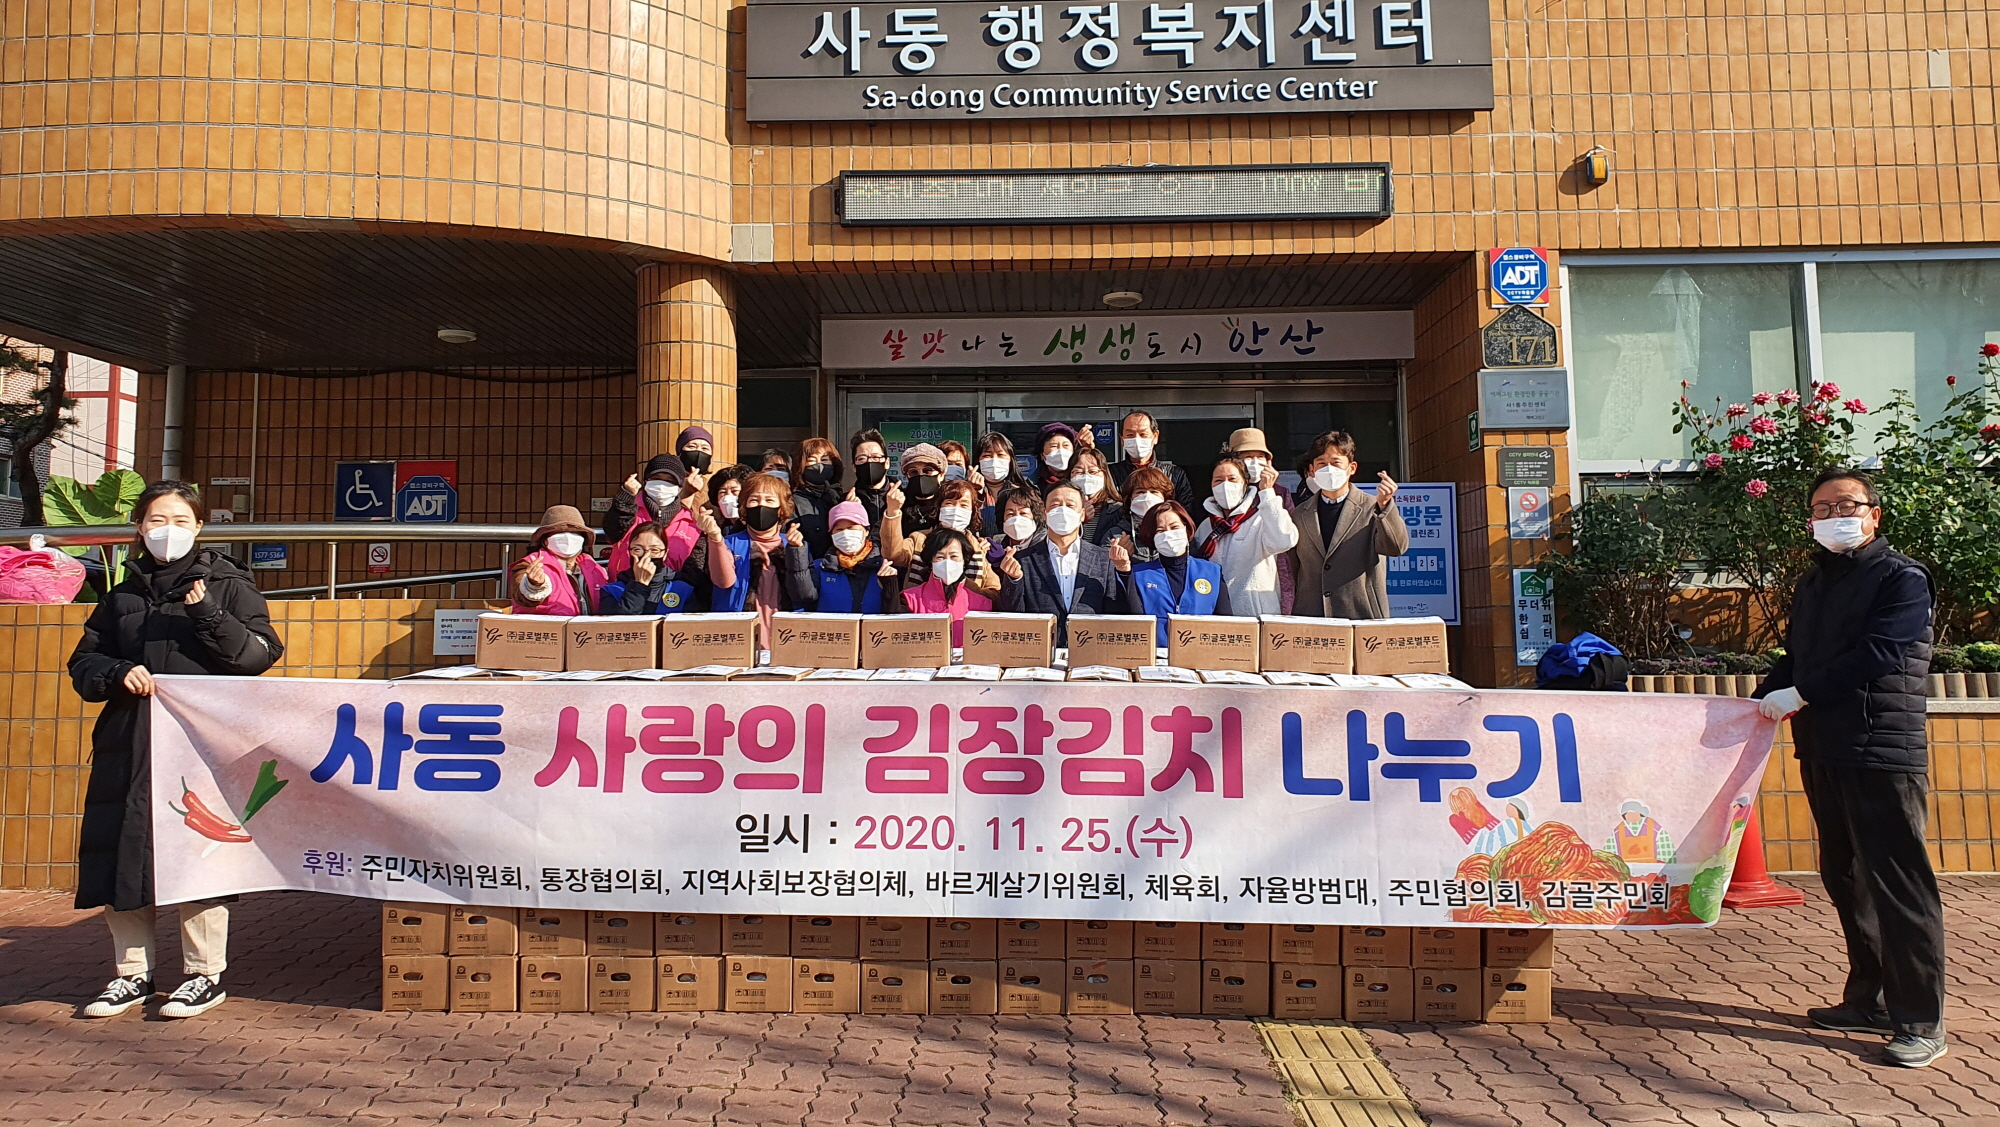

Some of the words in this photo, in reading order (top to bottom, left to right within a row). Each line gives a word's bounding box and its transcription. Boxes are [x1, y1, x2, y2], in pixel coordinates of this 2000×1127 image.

[807, 7, 949, 72] 사동
[987, 0, 1434, 69] 행정복지센터
[866, 84, 985, 112] Sa-dong
[993, 80, 1161, 109] Community
[1169, 78, 1272, 102] Service
[1280, 77, 1379, 100] Center
[1501, 265, 1540, 286] ADT
[1226, 318, 1325, 356] 안산
[1507, 336, 1554, 363] 171
[1097, 428, 1112, 437] ADT
[405, 494, 448, 516] ADT
[1397, 506, 1443, 527] 방문
[1518, 599, 1551, 611] 무더위
[309, 701, 506, 792] 사동
[533, 703, 827, 795] 사랑의
[862, 703, 1245, 799] 김장김치
[1281, 709, 1582, 803] 나누기
[734, 813, 812, 854] 일시
[854, 813, 967, 853] 2020.
[985, 815, 1044, 854] 11.
[1060, 815, 1194, 860] 25.(수)
[301, 849, 353, 878] 후원:
[360, 852, 531, 893] 주민자치위원회,
[539, 865, 671, 897] 통장협의회,
[681, 868, 915, 898] 지역사회보장협의체,
[925, 869, 1135, 902] 바르게살기위원회,
[1144, 873, 1229, 903] 체육회,
[1238, 875, 1377, 908] 자율방범대,
[1387, 877, 1531, 910] 주민협의회,
[1542, 880, 1672, 911] 감골주민회
